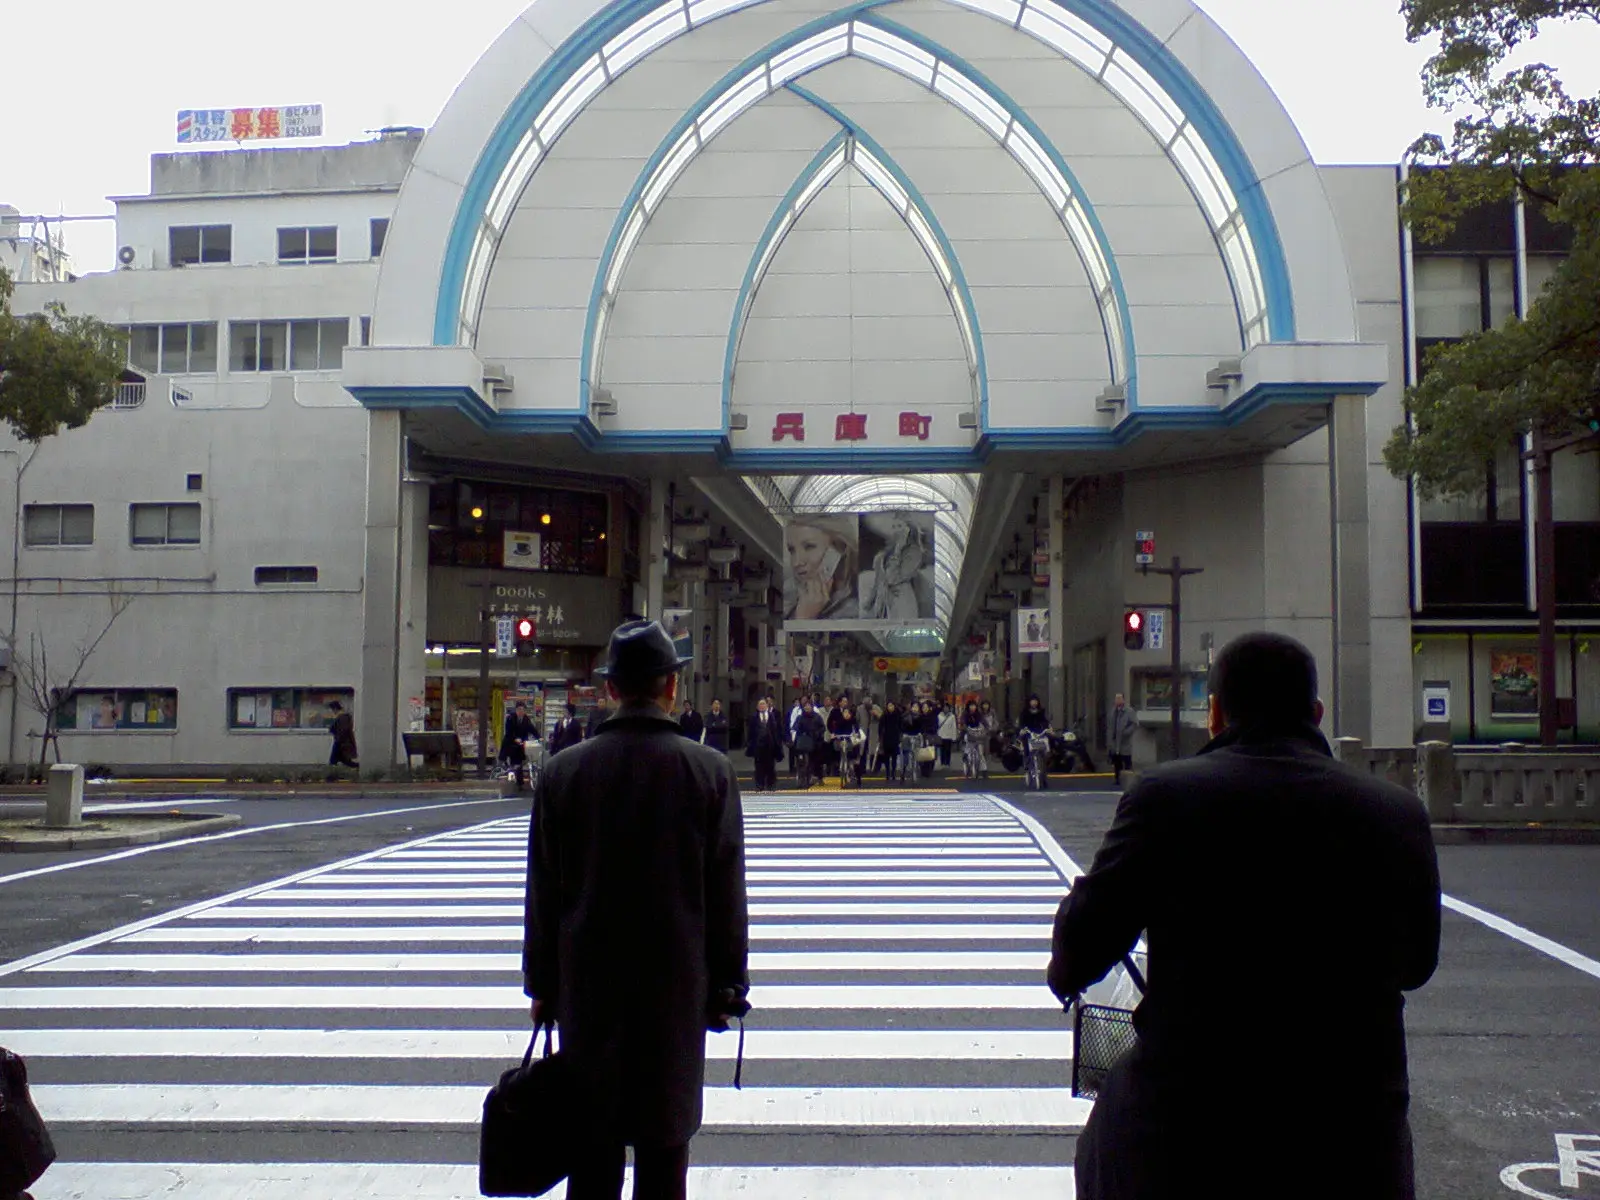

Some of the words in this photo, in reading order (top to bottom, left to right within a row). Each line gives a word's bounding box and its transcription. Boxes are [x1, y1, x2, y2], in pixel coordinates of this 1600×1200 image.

[231, 108, 280, 139] 募集
[772, 411, 933, 442] 兵庫町
